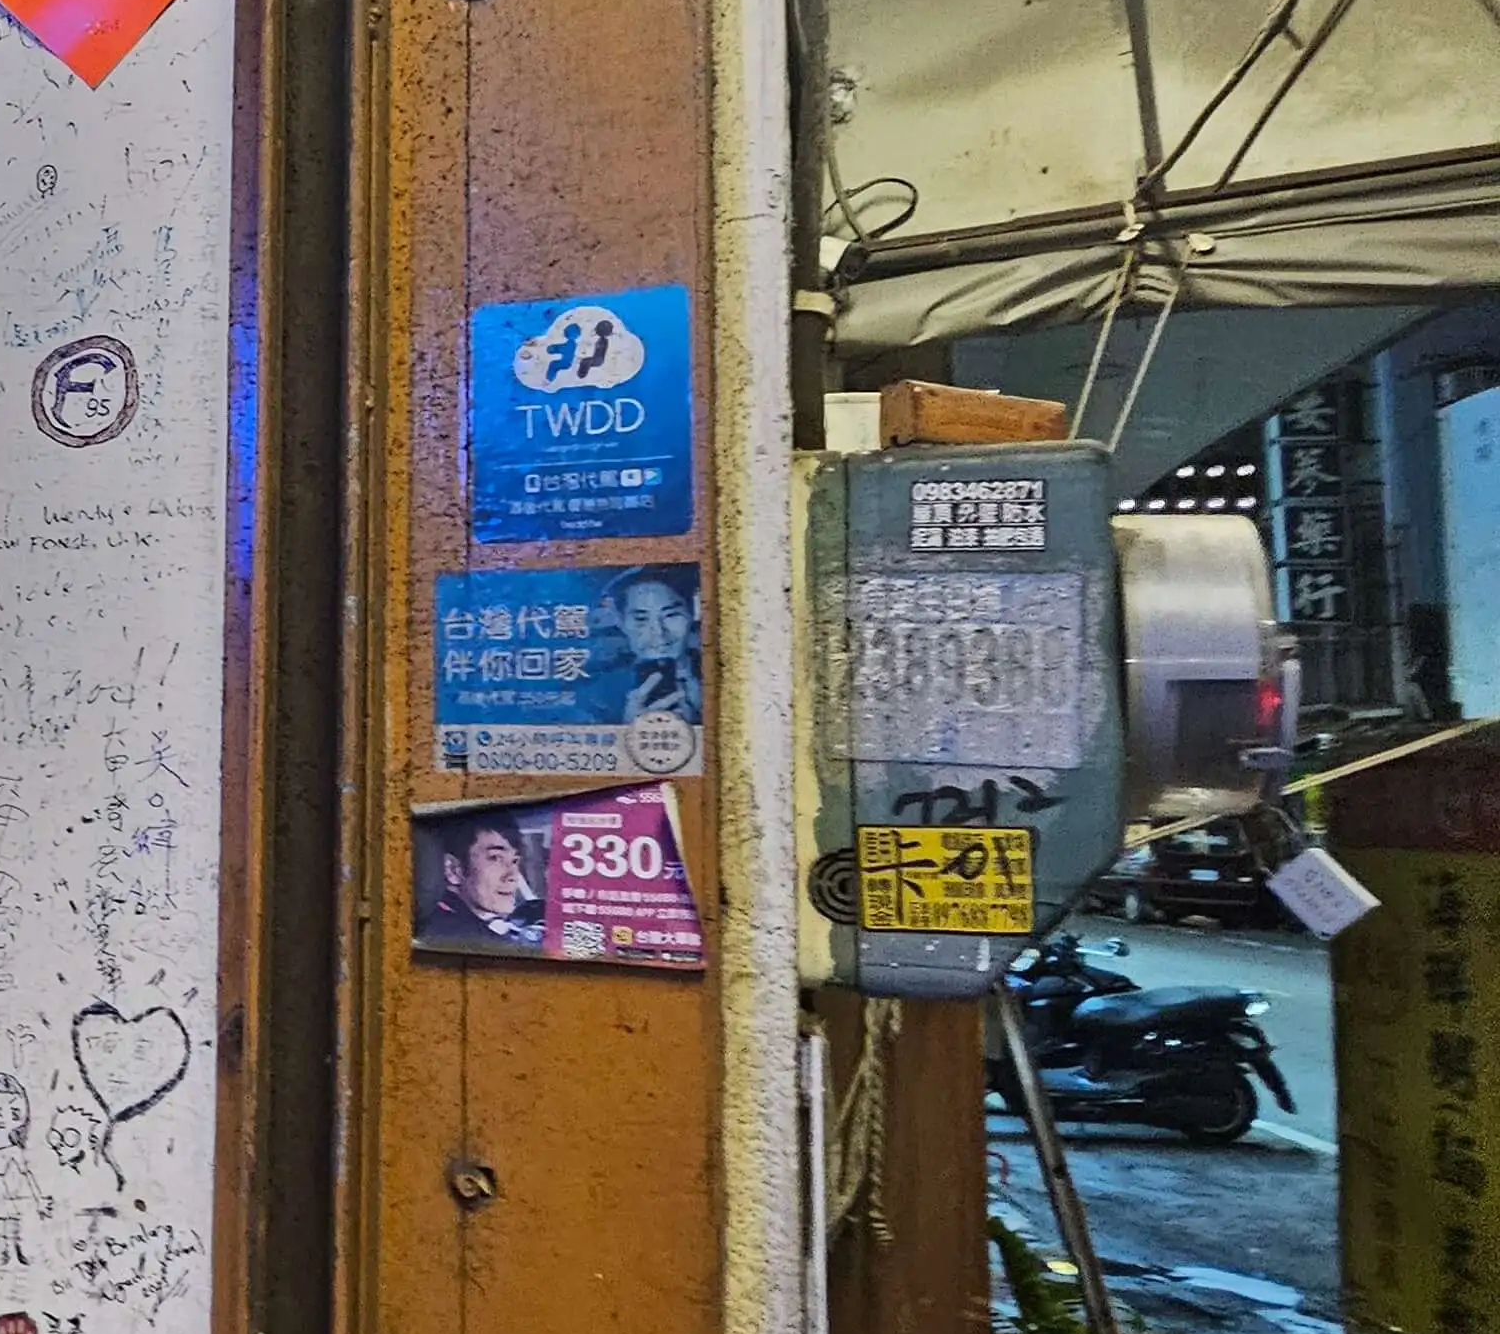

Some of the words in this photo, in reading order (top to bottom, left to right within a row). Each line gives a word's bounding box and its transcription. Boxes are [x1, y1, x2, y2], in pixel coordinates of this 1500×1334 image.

[514, 397, 646, 439] TWDD
[442, 602, 592, 642] 台灣代駕
[442, 646, 592, 684] 伴你回家
[561, 832, 664, 881] 330
